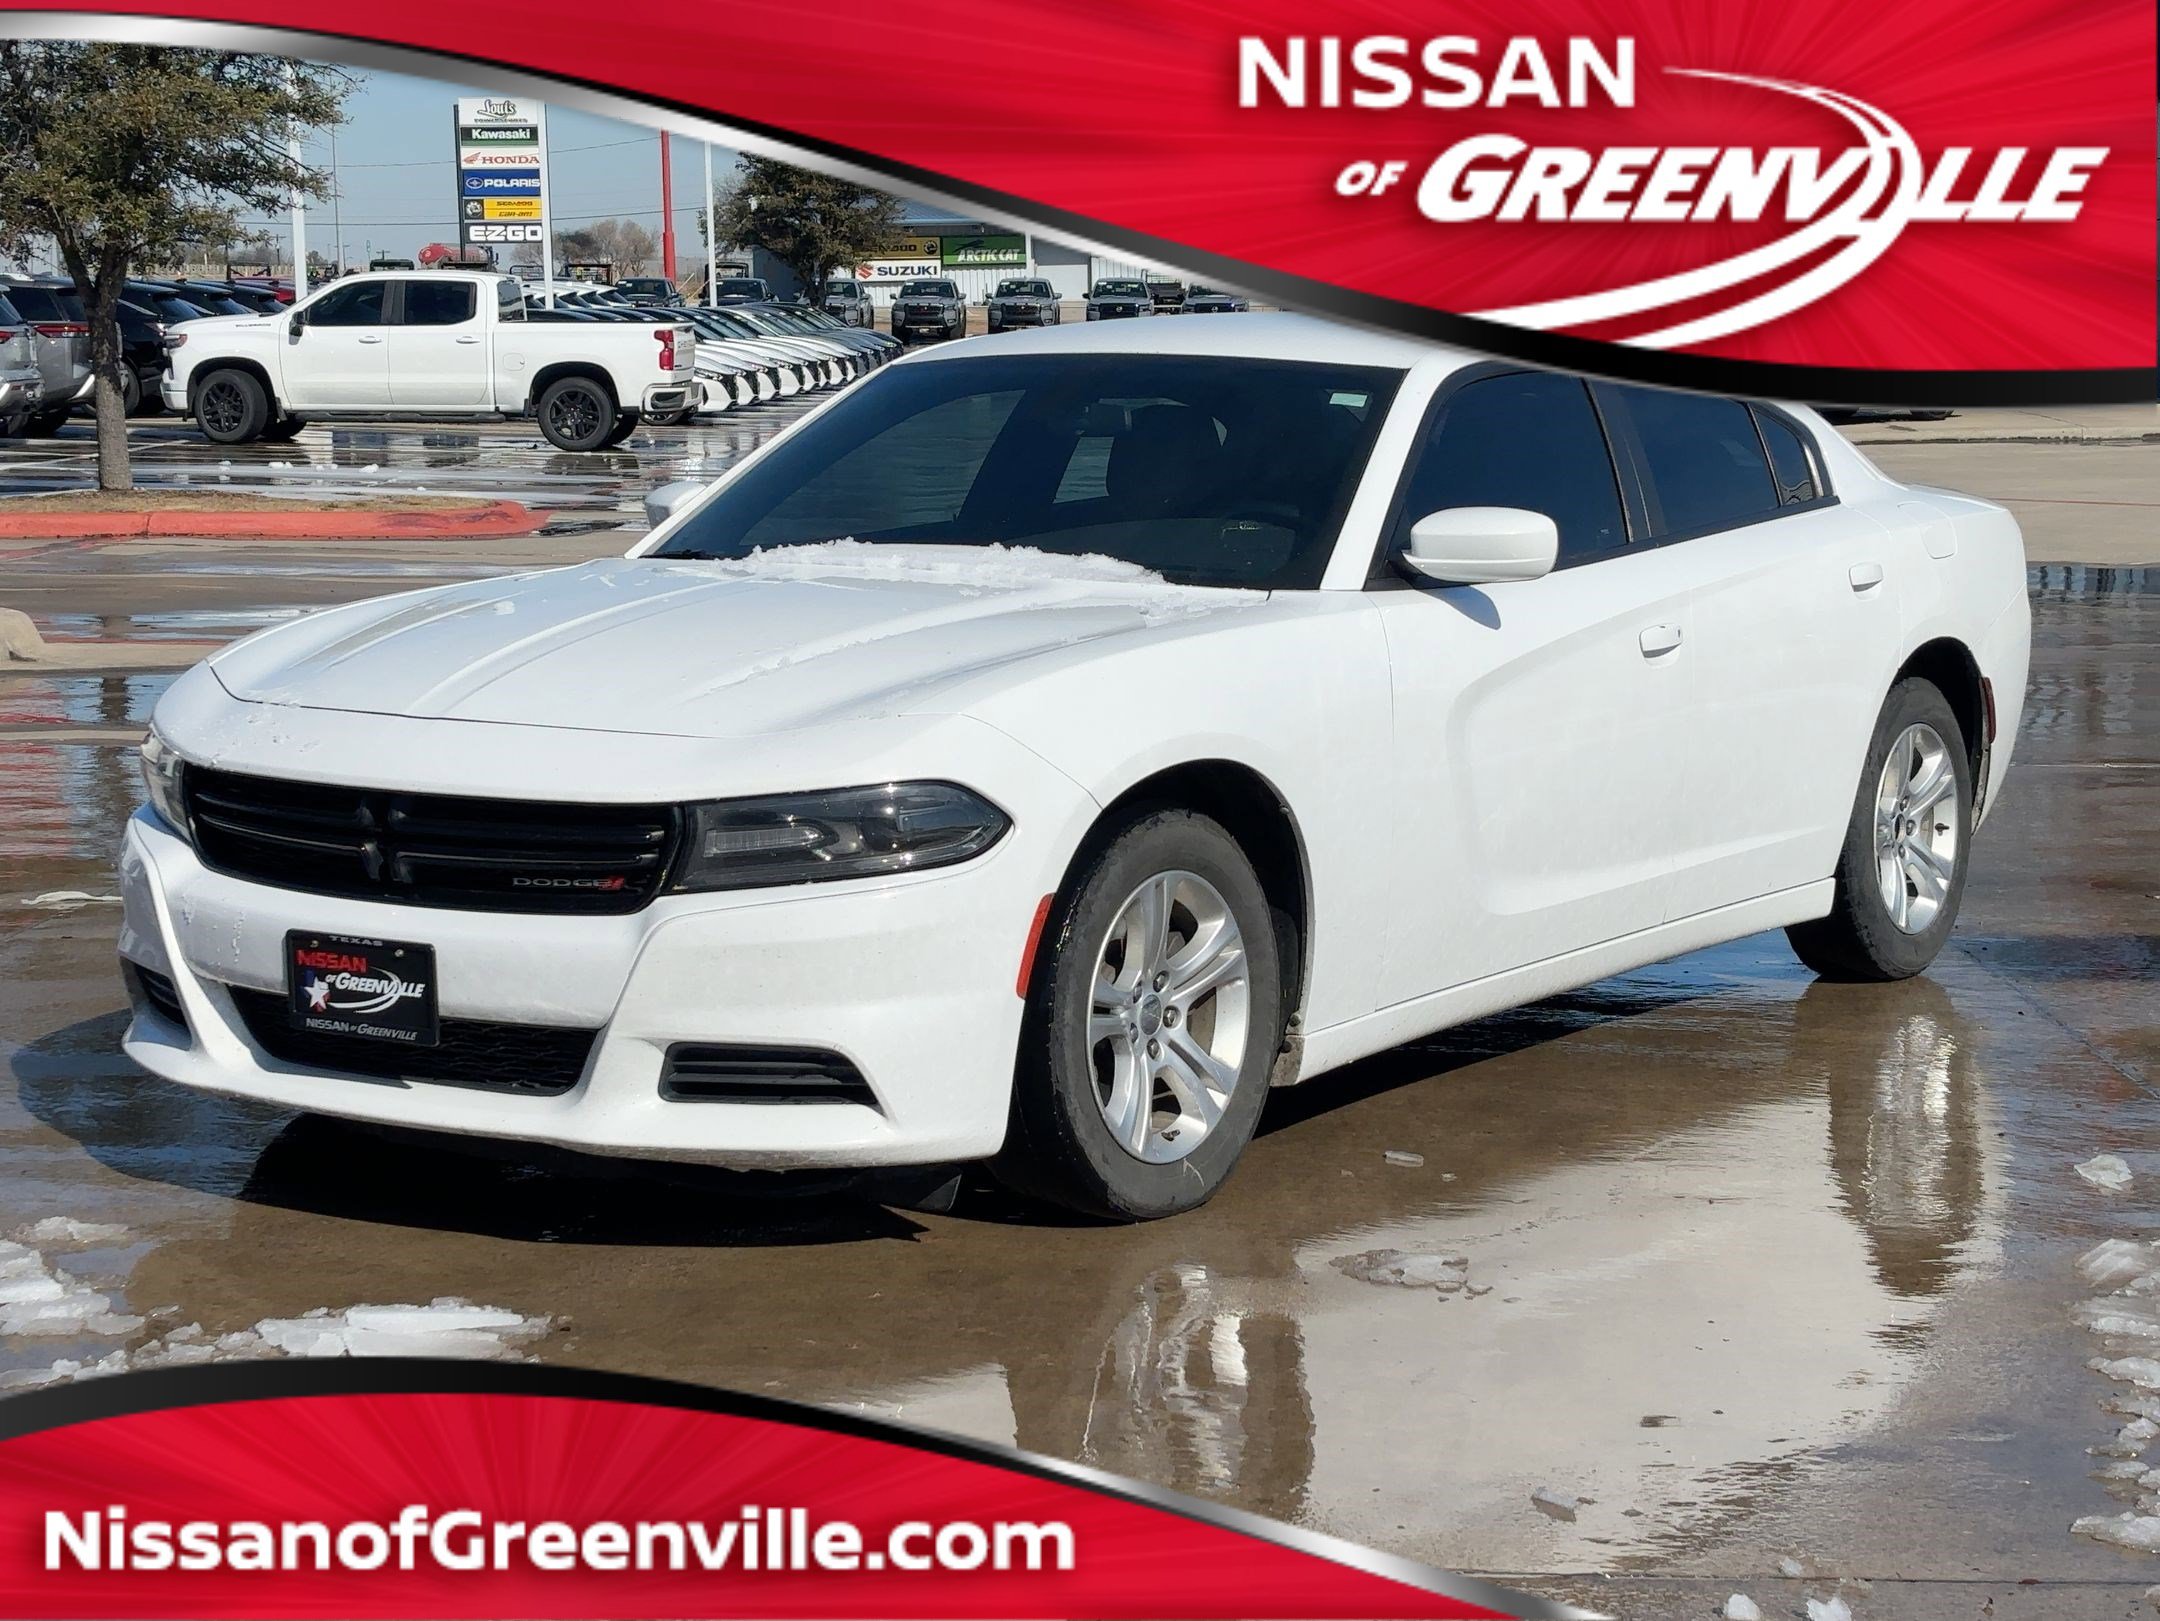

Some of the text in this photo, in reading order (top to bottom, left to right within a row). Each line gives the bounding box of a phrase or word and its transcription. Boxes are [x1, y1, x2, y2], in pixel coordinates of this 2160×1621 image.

[472, 129, 531, 139] Kawasaki
[482, 156, 540, 164] HONDA
[484, 178, 541, 188] POLARIS
[469, 225, 543, 241] EZGO
[956, 249, 1020, 262] ARCTIC CAT
[877, 265, 938, 276] SUZUKI
[512, 877, 611, 888] DODGE
[328, 935, 384, 947] TEXAS
[297, 949, 368, 973] NISSAN
[306, 1017, 350, 1032] NISSAN
[357, 1023, 418, 1041] GREENVILLE
